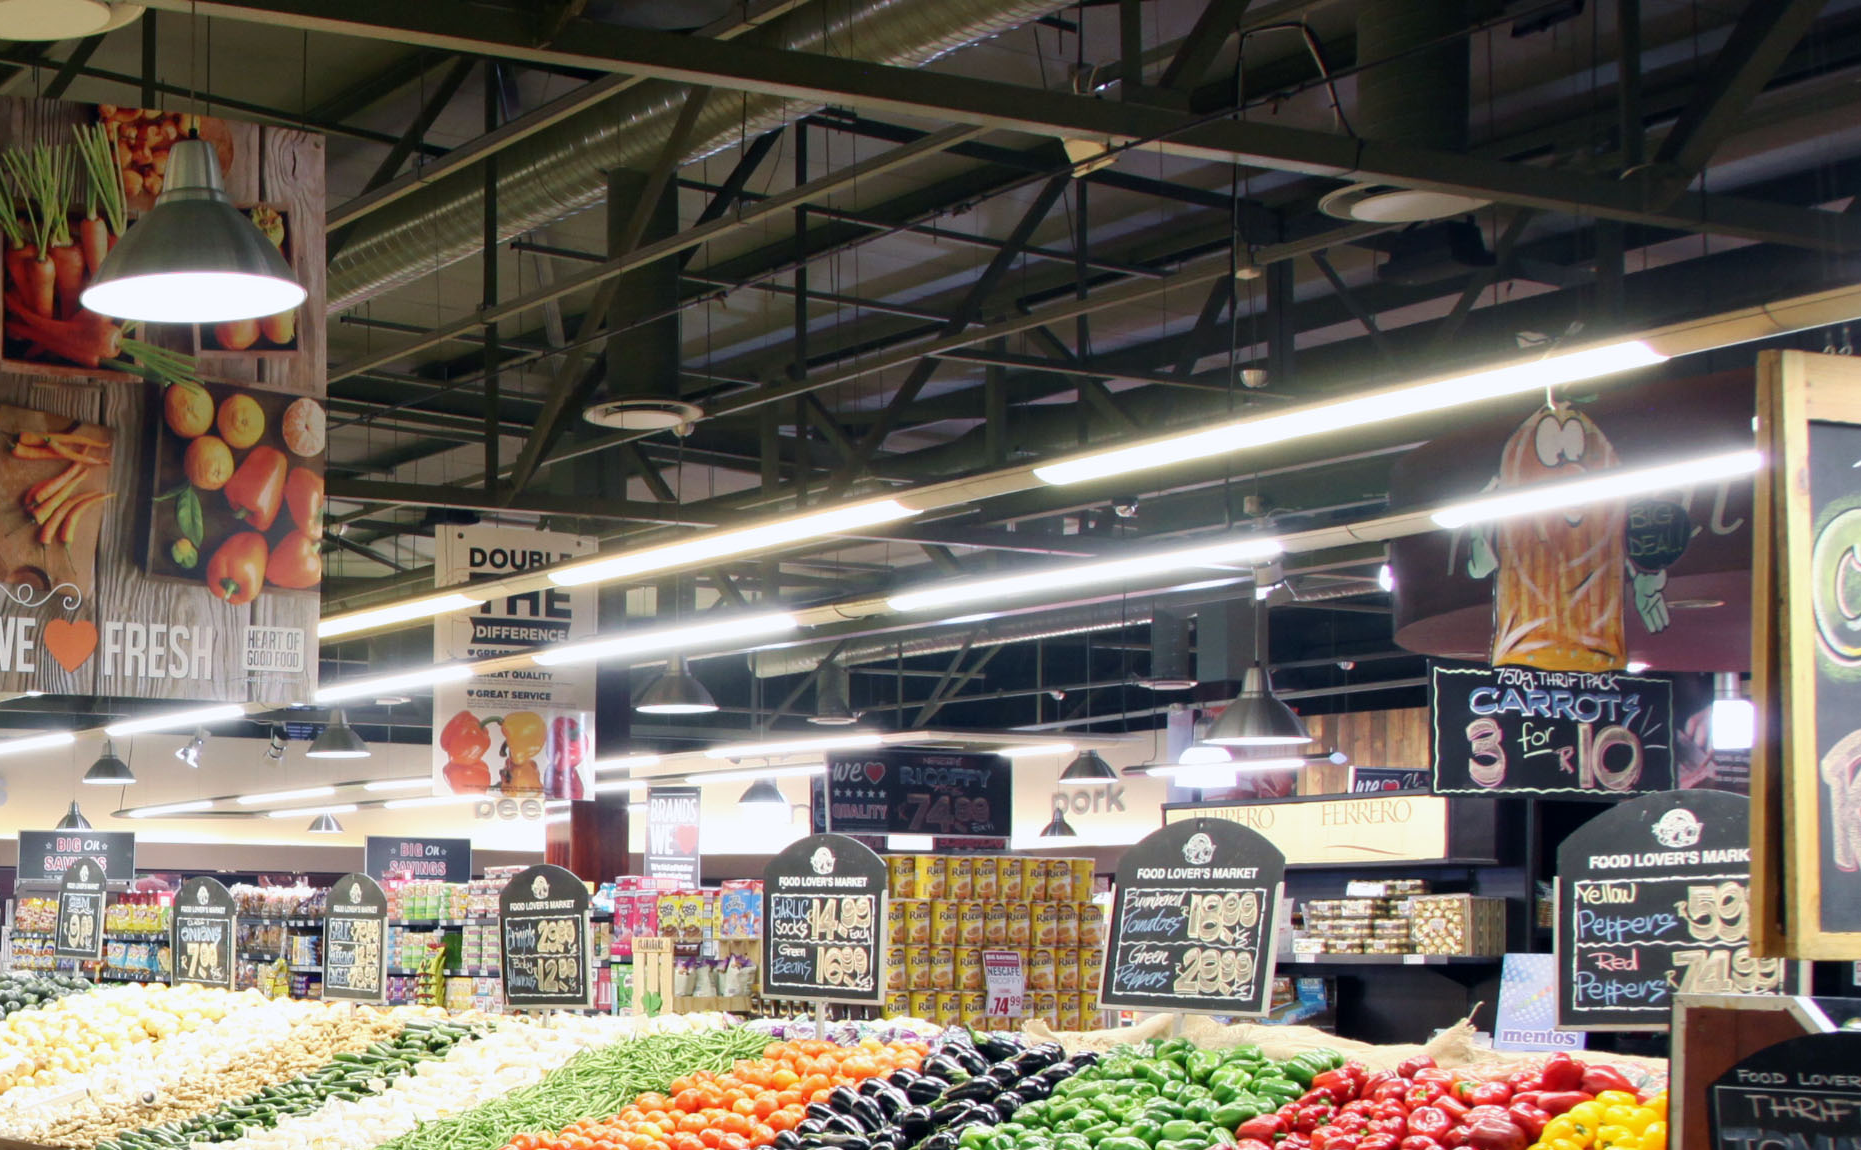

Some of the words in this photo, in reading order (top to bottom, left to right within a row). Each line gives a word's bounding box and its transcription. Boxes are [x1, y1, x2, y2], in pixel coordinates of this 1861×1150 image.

[1630, 504, 1675, 529] BIG
[247, 629, 283, 650] HEART
[286, 631, 300, 651] OF
[476, 625, 566, 642] DIFFERENCE
[104, 621, 213, 680] FRESH
[247, 649, 272, 666] GOOD
[275, 651, 299, 668] FOOD
[476, 649, 511, 657] GRE
[512, 671, 553, 681] QUALITY
[476, 690, 509, 698] GREAT
[511, 691, 551, 700] SERVICE
[1469, 686, 1640, 729] CARROTS
[1465, 717, 1506, 789] 3
[650, 798, 697, 822] BRANDS
[1051, 783, 1125, 818] pork
[832, 803, 888, 819] QUALITY
[1321, 800, 1412, 826] FERRERO
[56, 838, 82, 852] BIG
[400, 842, 424, 857] BIG
[650, 824, 674, 855] WE
[44, 856, 107, 871] SAVS
[1589, 854, 1631, 869] FOOD
[1634, 851, 1700, 868] LOVER'S
[1702, 848, 1750, 864] MARK
[778, 876, 800, 887] FOOD
[801, 876, 834, 887] LOVER'S
[834, 877, 868, 888] MARKET
[1137, 868, 1166, 880] FOOD
[1167, 868, 1210, 880] LOVER'S
[1212, 867, 1258, 879] MARKET
[1576, 883, 1636, 905] Yellow
[510, 902, 525, 911] FOOD
[550, 899, 575, 909] MARKET
[772, 899, 809, 919] GARLIC
[1577, 909, 1678, 941] Peppers
[180, 926, 222, 945] ONIONS
[778, 944, 806, 957] Green
[1128, 944, 1170, 965] Green
[1587, 948, 1639, 971] Red
[773, 957, 812, 981] Beans
[1576, 971, 1668, 1005] Peppers
[1502, 1029, 1577, 1045] mentos
[1737, 1069, 1788, 1085] FOOD
